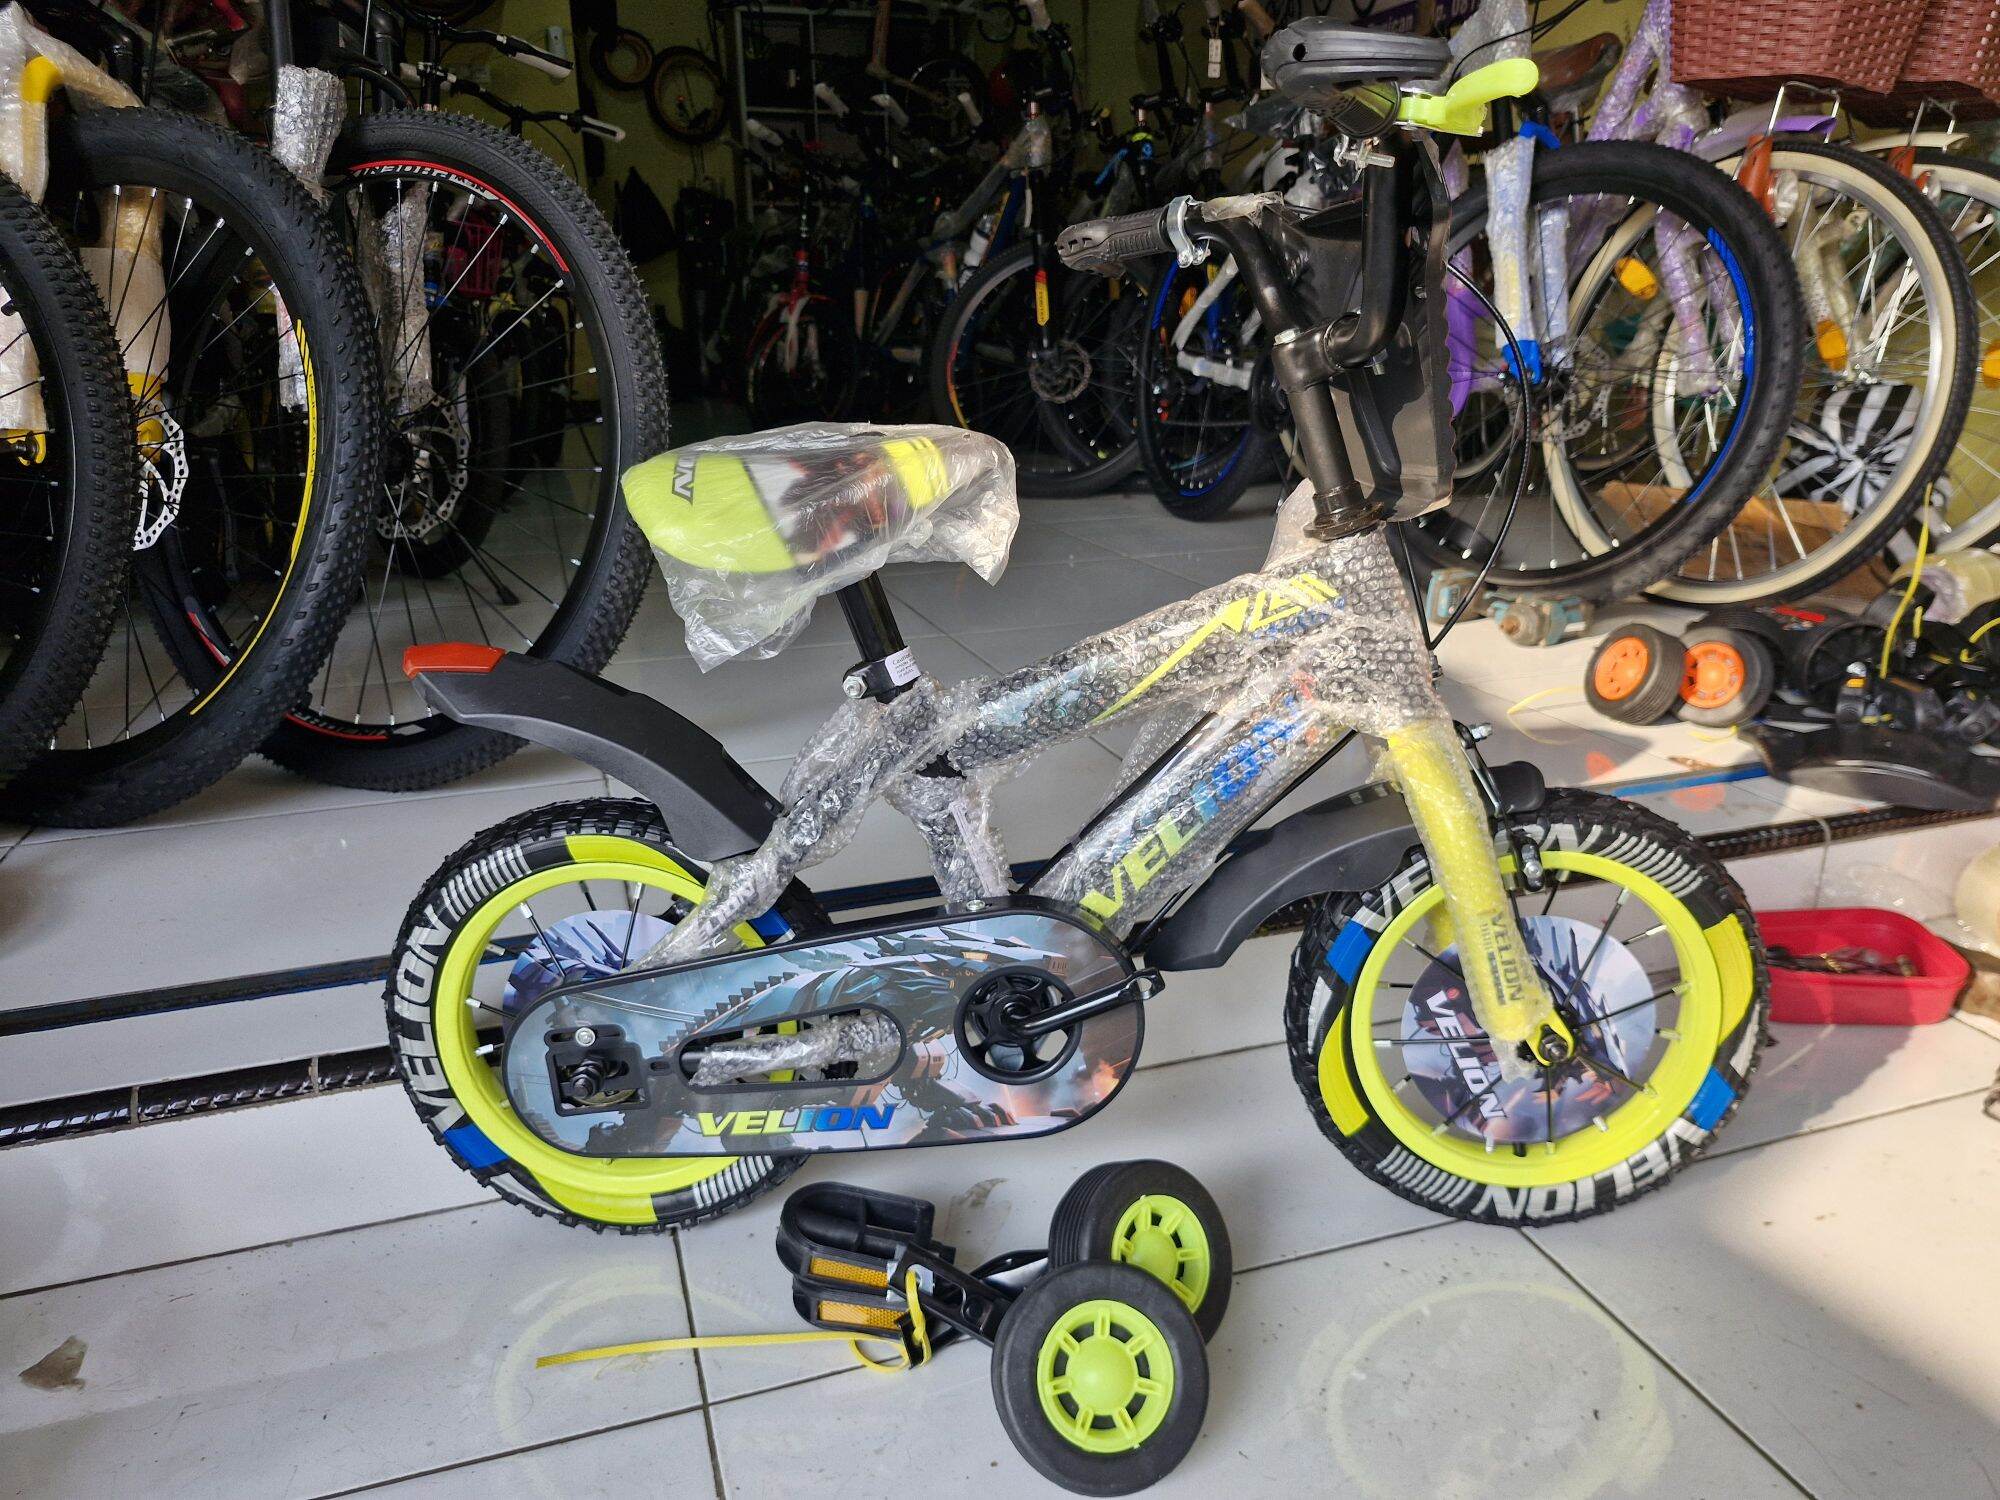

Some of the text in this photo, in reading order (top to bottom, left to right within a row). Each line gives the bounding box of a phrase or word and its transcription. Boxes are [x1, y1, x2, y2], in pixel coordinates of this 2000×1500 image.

[1491, 911, 1524, 1001] VELION
[394, 903, 466, 1135] VELION
[1426, 989, 1508, 1120] VELION
[698, 1103, 899, 1136] VELION
[1471, 1117, 1709, 1220] VELION
